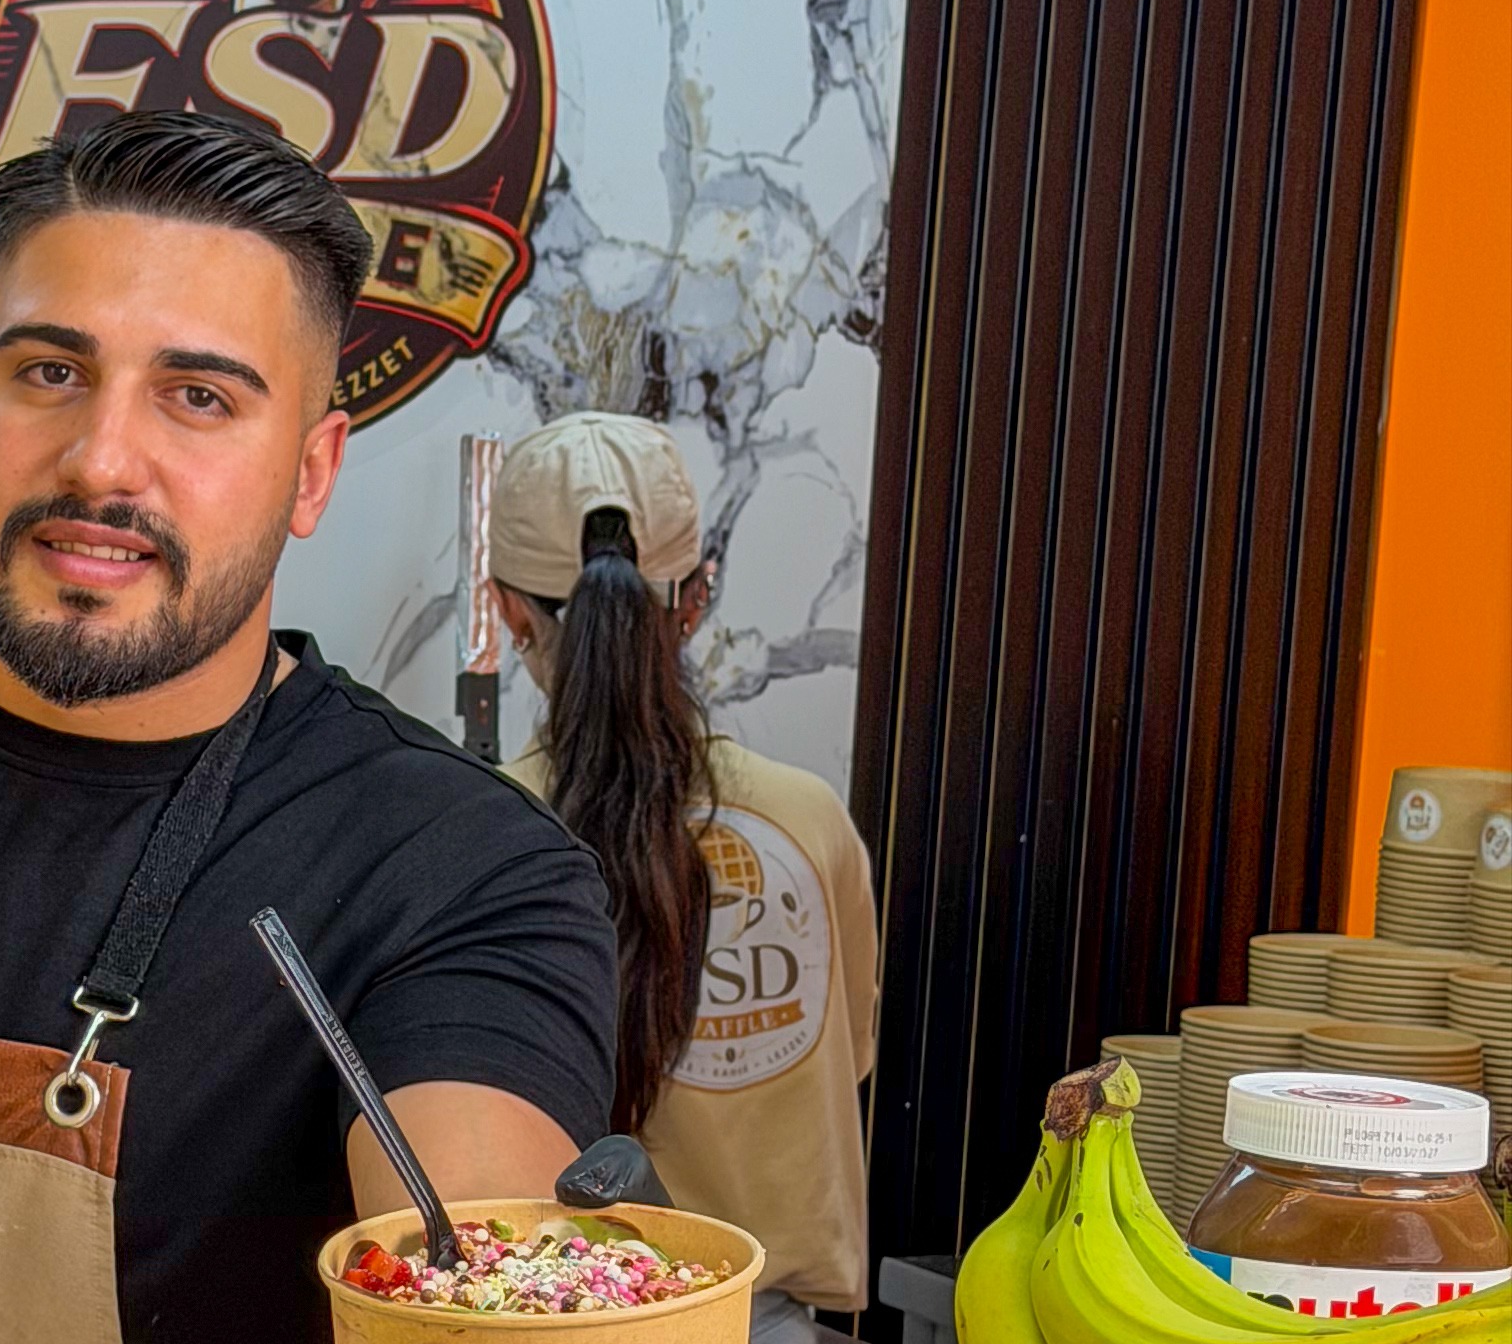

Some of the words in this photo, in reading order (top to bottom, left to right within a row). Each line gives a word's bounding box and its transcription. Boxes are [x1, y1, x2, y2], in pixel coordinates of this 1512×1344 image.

[332, 336, 414, 406] EZZET
[703, 944, 799, 1004] SD
[701, 1010, 777, 1038] AFFLE
